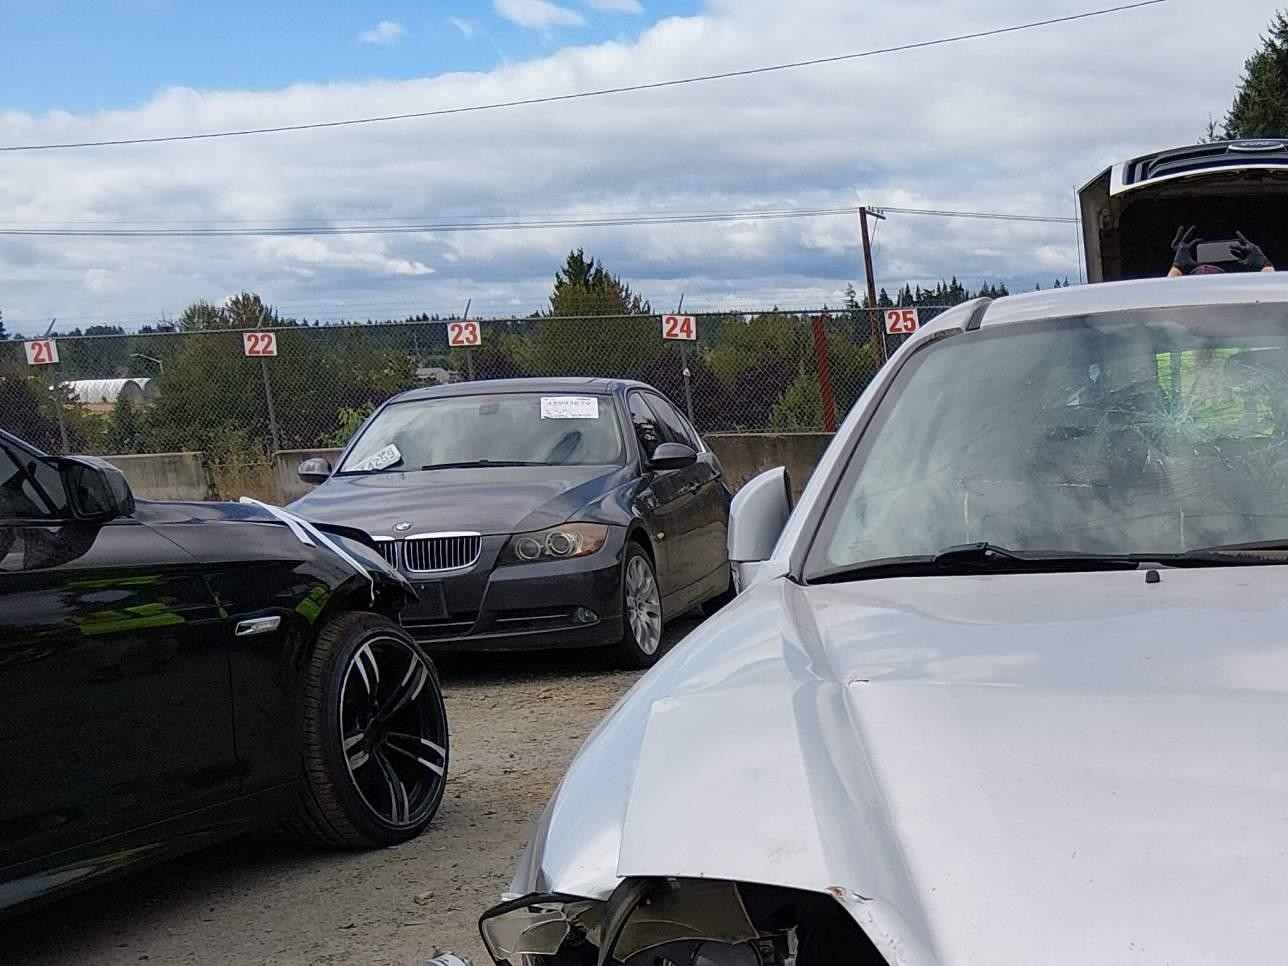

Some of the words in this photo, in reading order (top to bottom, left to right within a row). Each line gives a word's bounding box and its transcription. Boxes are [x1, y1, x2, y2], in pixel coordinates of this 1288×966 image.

[665, 317, 693, 338] 24
[888, 311, 916, 332] 25
[247, 334, 273, 354] 22
[451, 323, 477, 344] 23
[31, 342, 53, 362] 21
